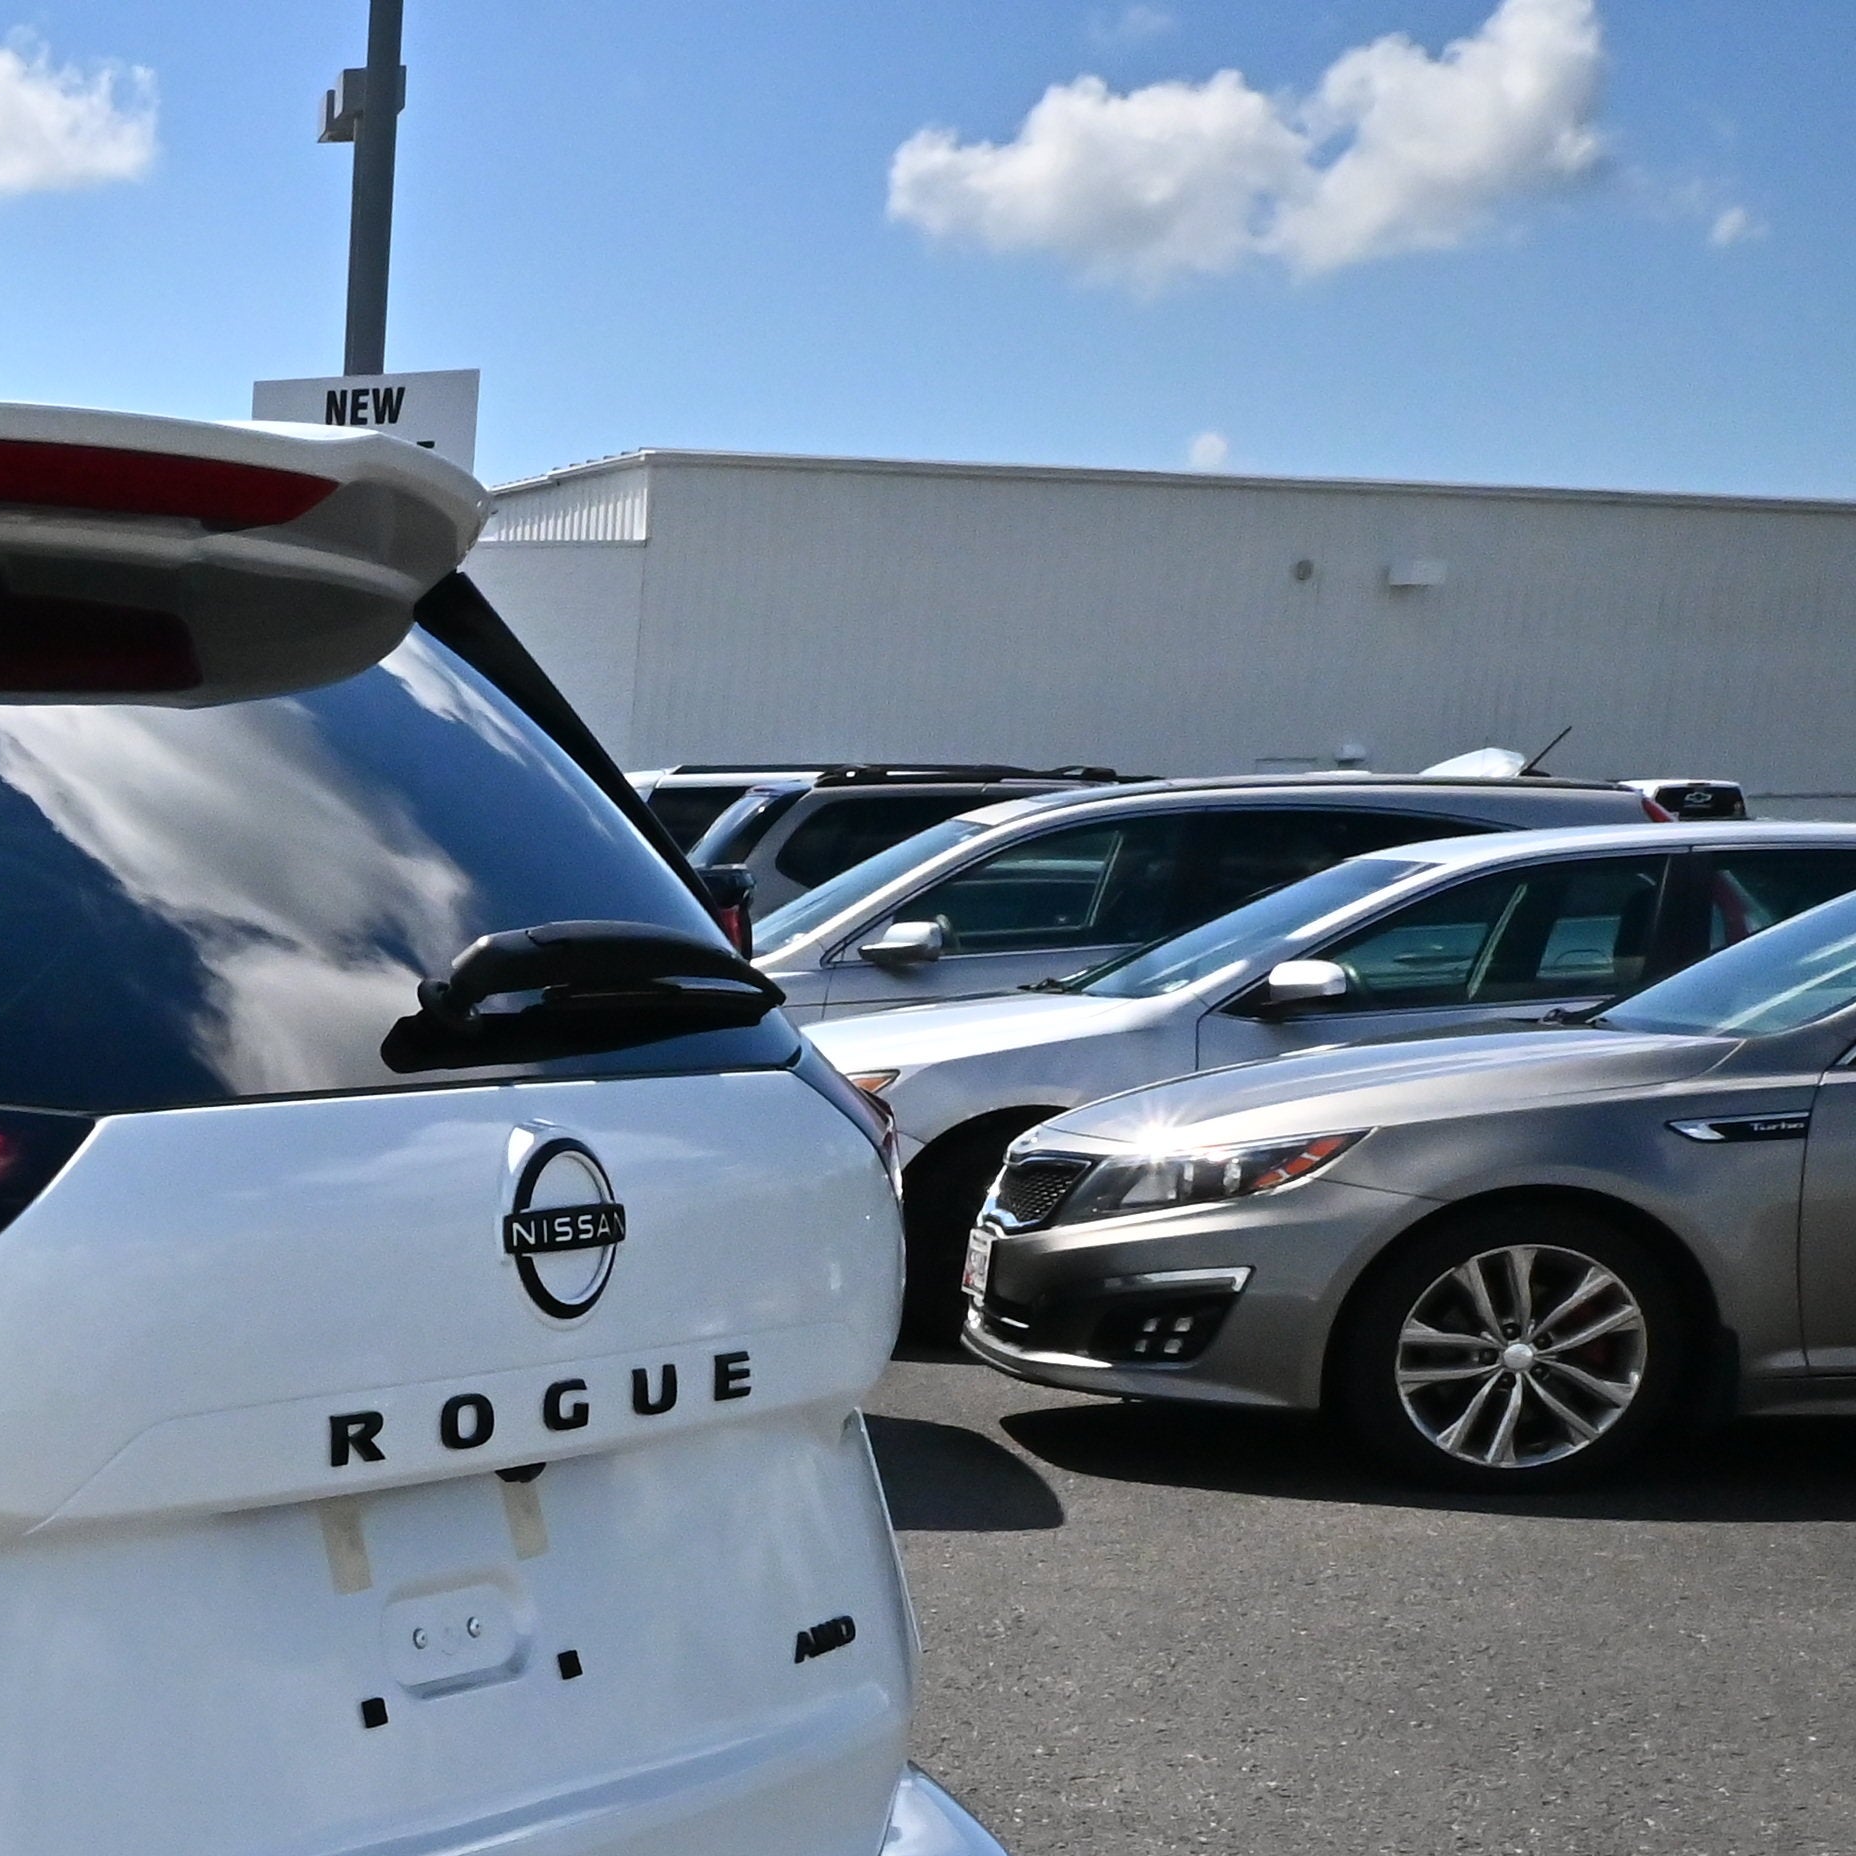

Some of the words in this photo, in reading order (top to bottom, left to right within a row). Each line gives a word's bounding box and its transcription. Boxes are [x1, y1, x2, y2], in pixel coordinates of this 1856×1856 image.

[325, 386, 406, 426] NEW
[511, 1210, 625, 1247] NISSAN
[329, 1350, 753, 1468] ROGUE
[793, 1614, 857, 1665] AWD
